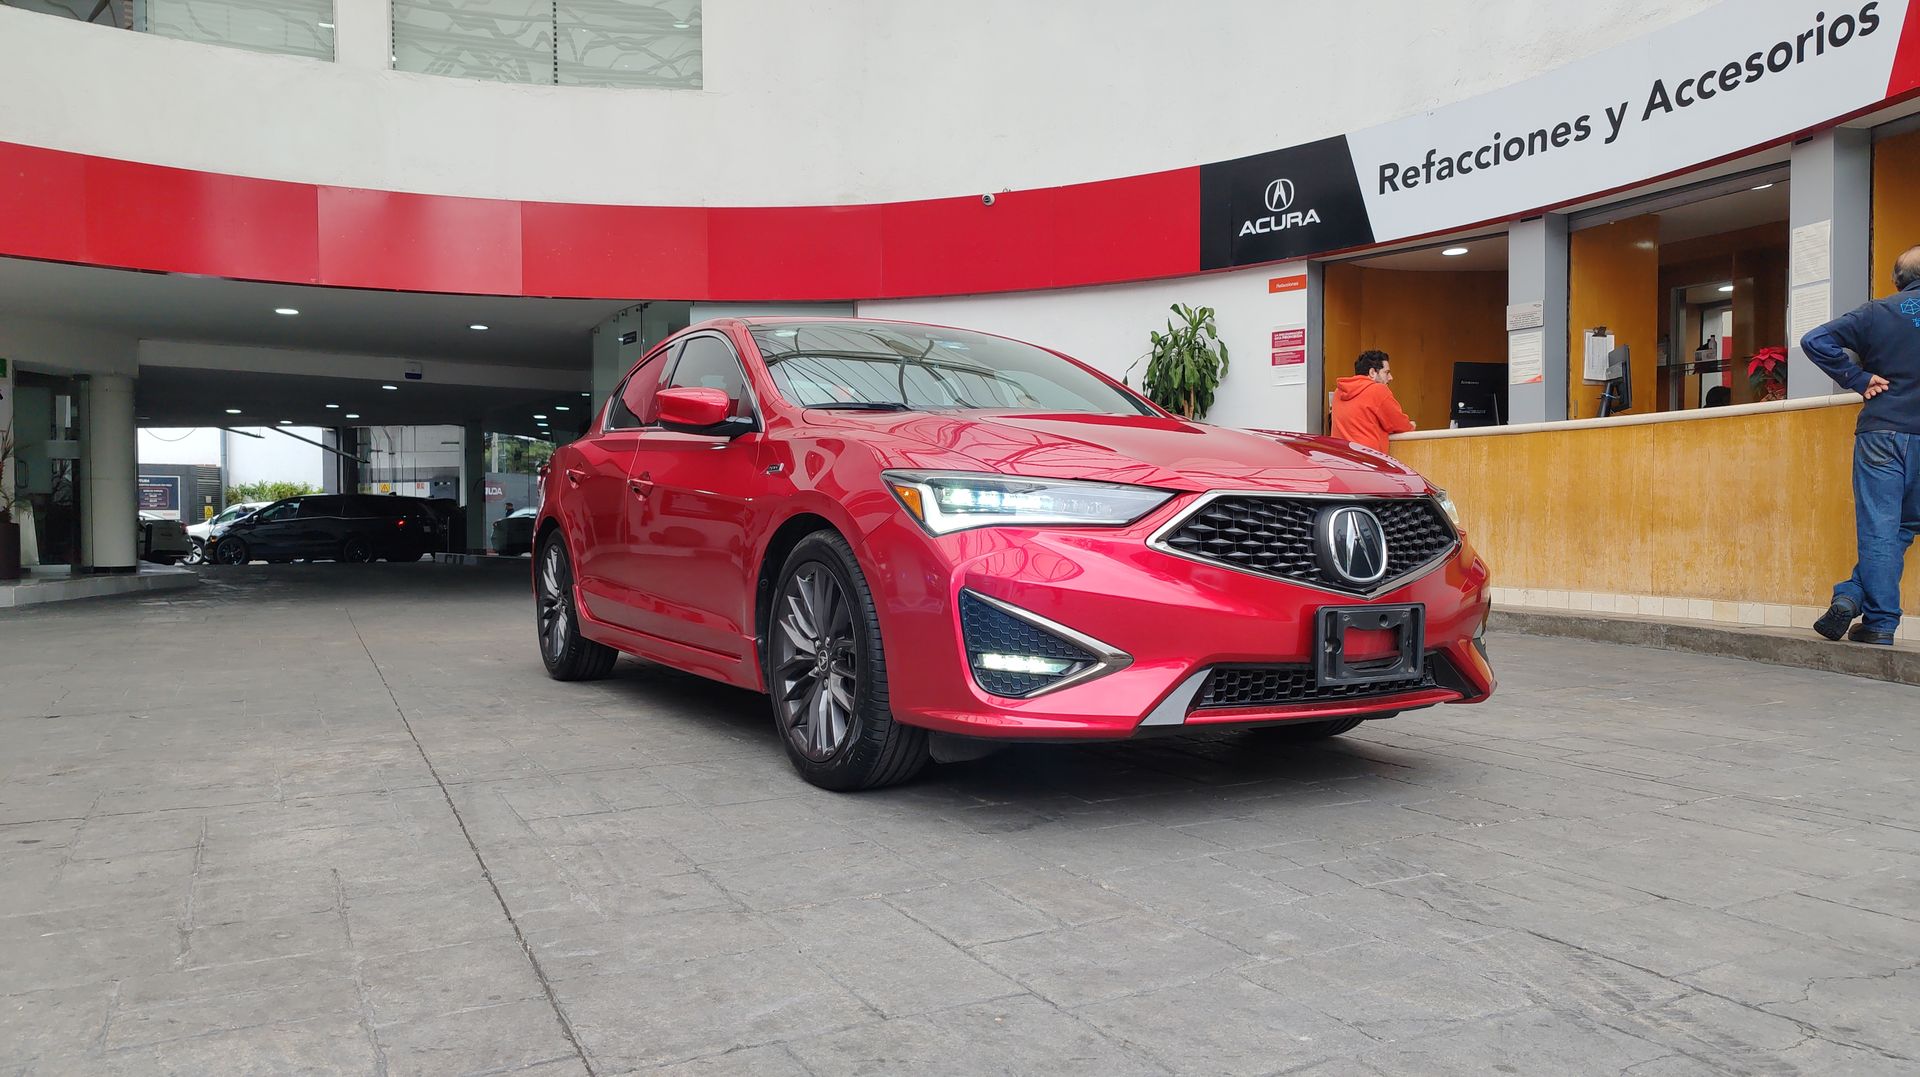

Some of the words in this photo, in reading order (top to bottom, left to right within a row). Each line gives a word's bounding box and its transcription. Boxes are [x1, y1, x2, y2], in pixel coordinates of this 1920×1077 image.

[1378, 114, 1592, 195] Refacciones
[1604, 100, 1629, 144] y
[1641, 1, 1880, 122] Accesorios
[1239, 208, 1321, 237] ACURA
